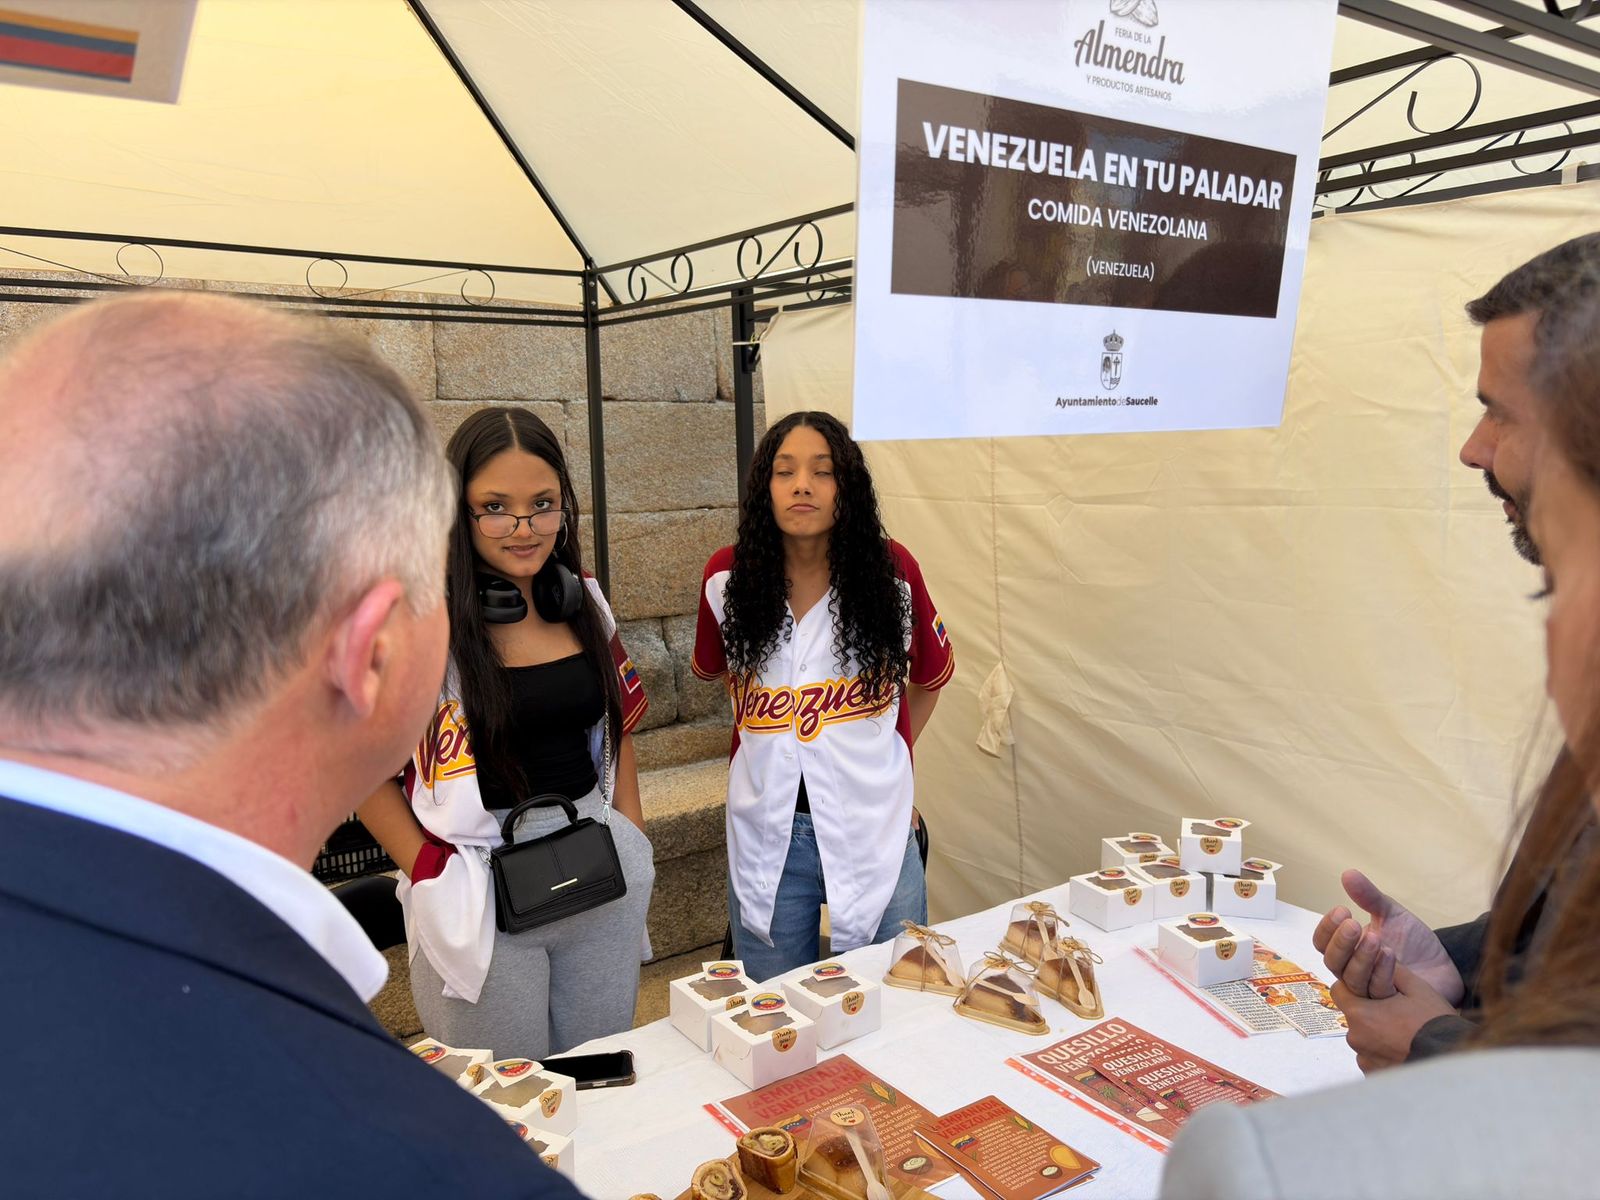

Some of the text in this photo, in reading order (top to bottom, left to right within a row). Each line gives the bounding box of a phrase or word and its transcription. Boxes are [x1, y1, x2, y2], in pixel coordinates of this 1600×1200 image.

[1115, 26, 1152, 45] FERIA DE LA
[1074, 19, 1185, 86] Almendra
[1086, 74, 1172, 102] Y PRODUCTOS ARTESANOS
[922, 121, 1284, 210] VENEZUELA EN TU PALADAR
[1028, 198, 1208, 241] COMIDA VENEZOLANA
[1086, 255, 1155, 282] (VENEZUELA)
[730, 671, 898, 737] Venezue
[1173, 880, 1186, 888] Thank
[1219, 941, 1233, 949] Thank
[729, 998, 746, 1009] Thank
[845, 993, 860, 1005] Thank
[776, 1029, 793, 1039] Thank
[1037, 1023, 1127, 1065] QUESILLO
[1102, 1048, 1164, 1071] QUESILLO
[1111, 1055, 1172, 1078] VENEZOLANO
[1137, 1060, 1197, 1085] QUESILLO
[758, 1060, 850, 1106] EMPANADA
[1147, 1067, 1206, 1092] VENEZOLANO
[754, 1068, 867, 1120] VENEZOLANA
[834, 1109, 855, 1119] Thank
[938, 1100, 1000, 1128] EMPANADA
[938, 1106, 1012, 1139] VENEZOLANA
